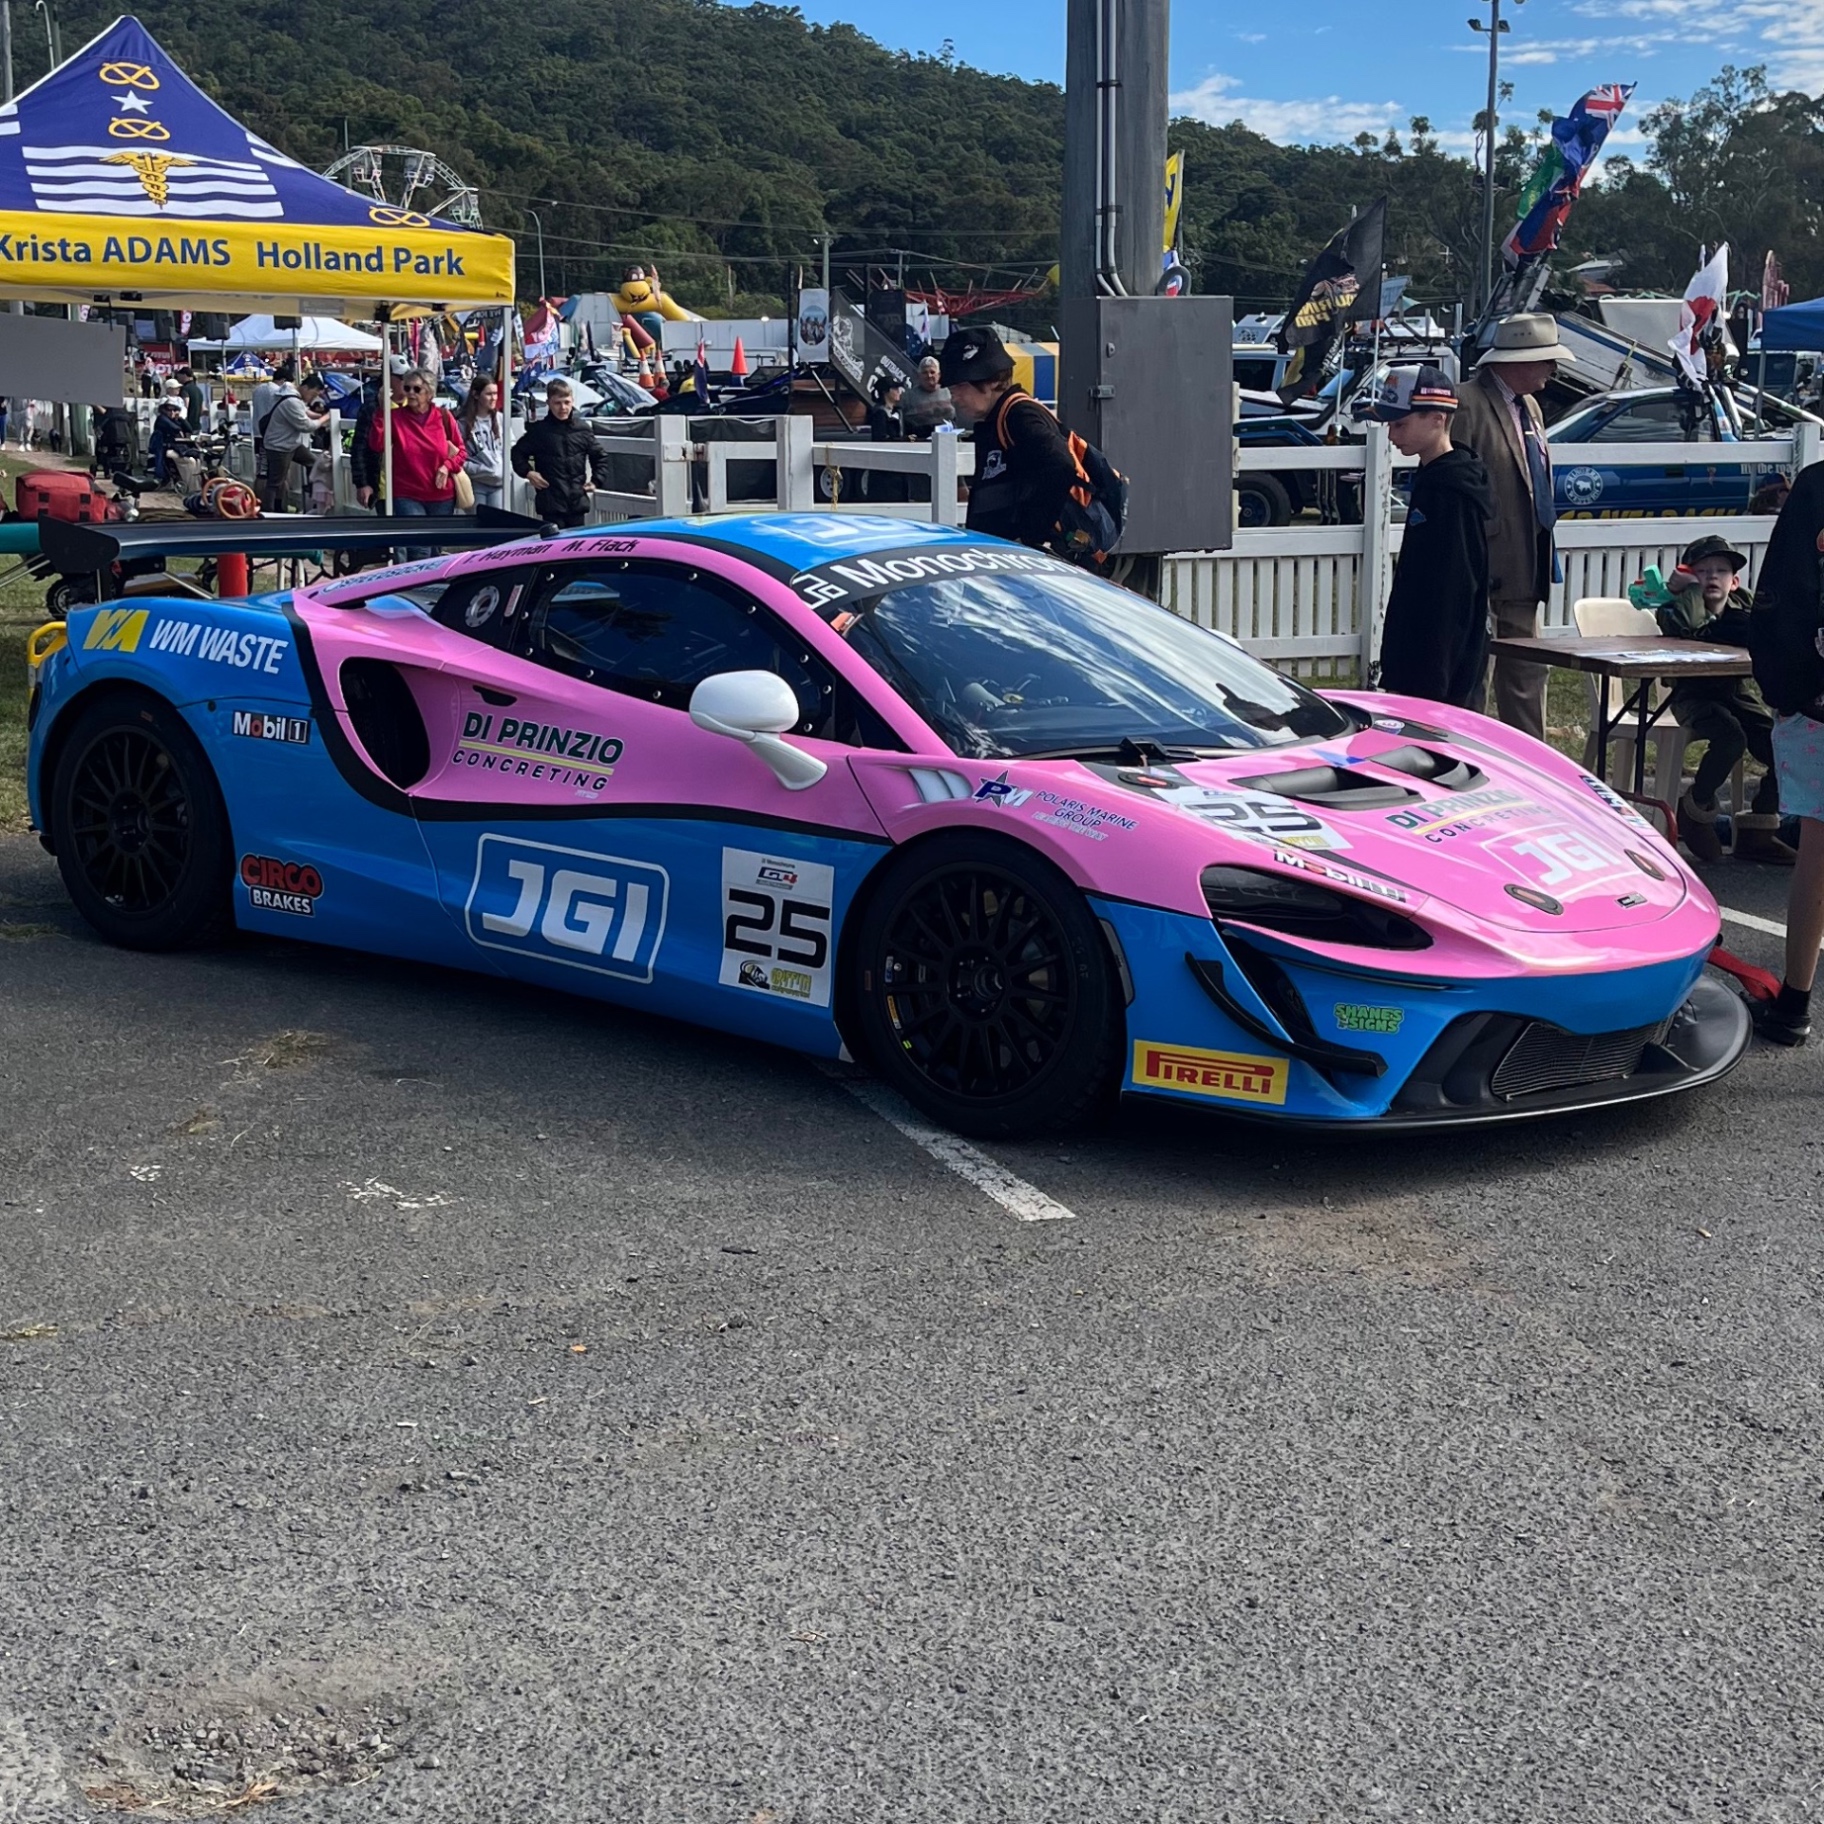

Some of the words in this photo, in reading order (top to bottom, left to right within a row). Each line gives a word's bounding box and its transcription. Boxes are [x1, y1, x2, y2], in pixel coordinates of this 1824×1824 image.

[0, 233, 92, 263] Krista
[102, 236, 231, 266] ADAMS
[256, 241, 384, 273] Holland
[393, 247, 466, 276] Park
[479, 543, 554, 563] Hayman
[561, 540, 583, 552] M.
[587, 539, 641, 553] Flack
[829, 548, 1092, 589] Monochrom
[149, 618, 202, 656] WM
[198, 626, 289, 675] WASTE
[233, 711, 287, 741] Mobil
[462, 711, 493, 741] DI
[497, 717, 624, 765] PRINZIO
[452, 749, 609, 791] CONCRETING
[1035, 790, 1088, 813] POLARIS
[1086, 806, 1139, 831] MARINE
[1053, 807, 1103, 829] GROUP
[1384, 810, 1430, 830] DI
[1417, 789, 1525, 819] PRINZIO
[1425, 805, 1553, 844] CONCRETING
[242, 856, 322, 897] CIRCO
[1511, 831, 1624, 886] JGI
[252, 889, 312, 915] BRAKES
[481, 858, 650, 962] JGI
[725, 888, 830, 969] 25
[1335, 1004, 1402, 1021] SHANES
[1348, 1017, 1398, 1032] SIGNS
[1146, 1050, 1275, 1095] PIRELLI
